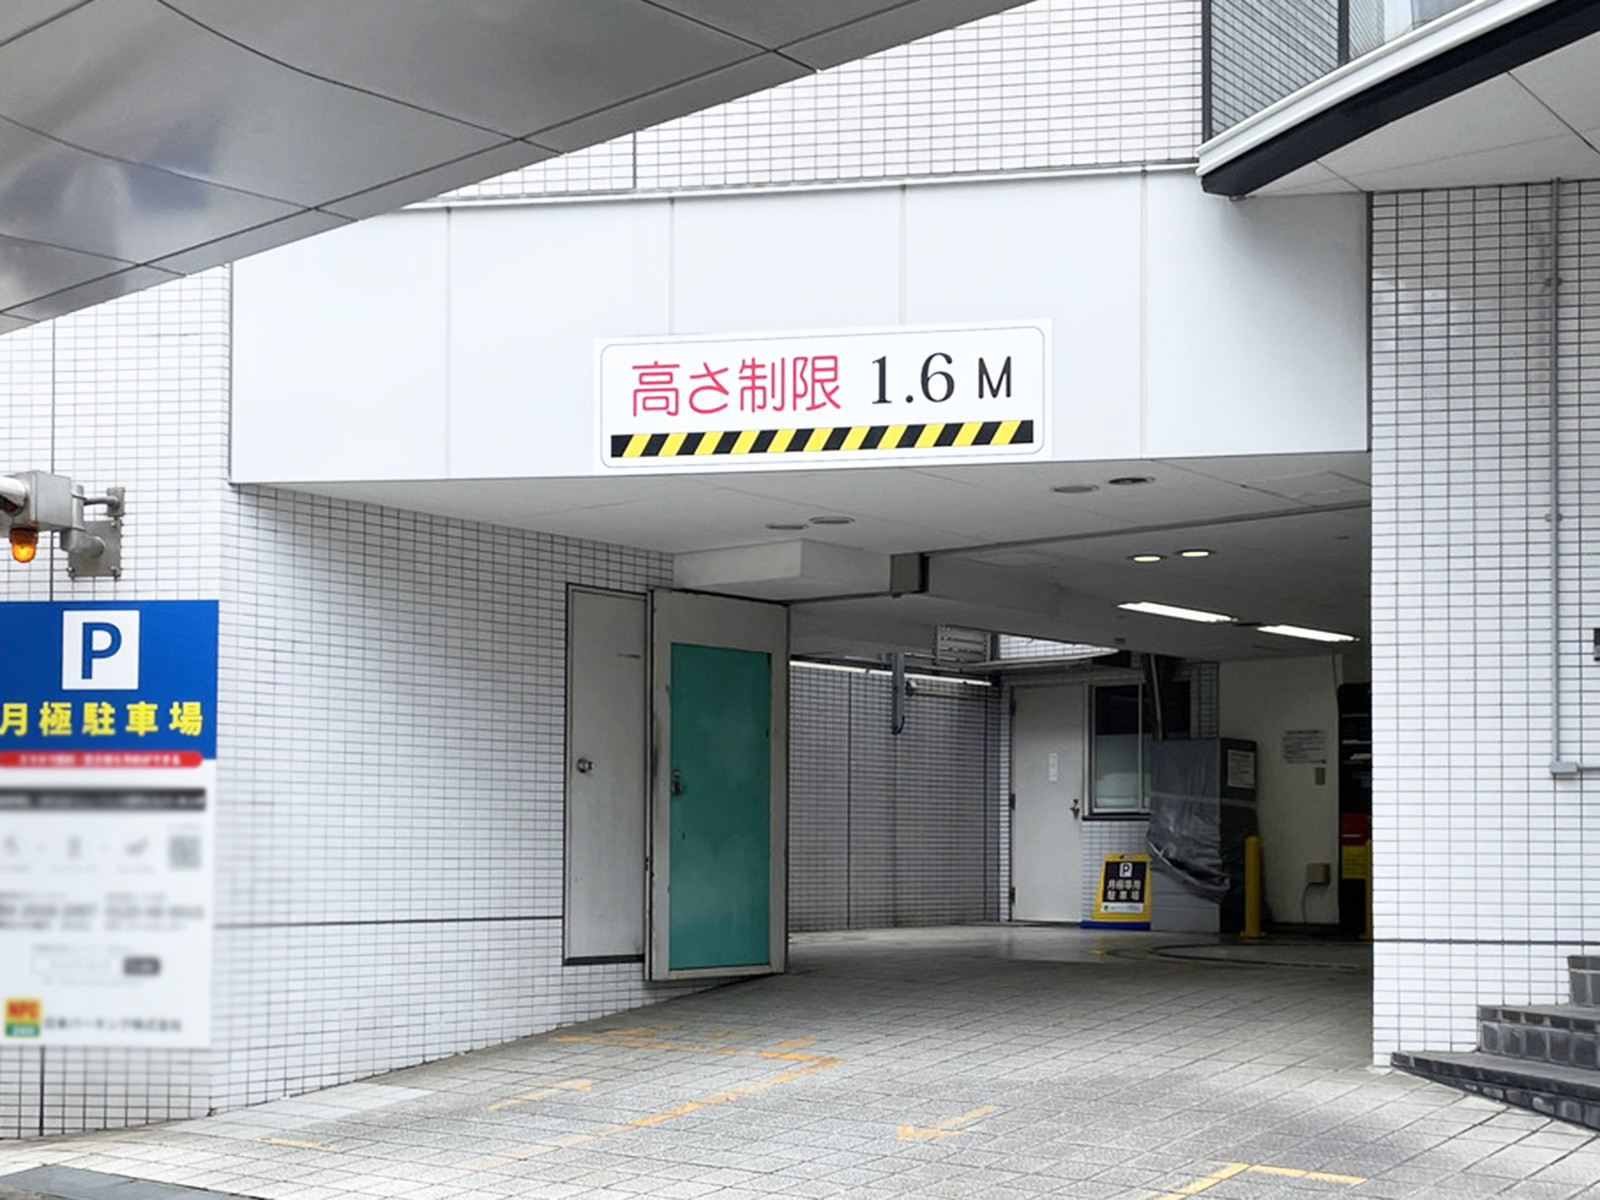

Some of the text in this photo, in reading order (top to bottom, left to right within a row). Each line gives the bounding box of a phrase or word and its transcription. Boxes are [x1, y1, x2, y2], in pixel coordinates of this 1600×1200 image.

[632, 352, 1012, 417] 高さ制限 1.6 M
[81, 621, 122, 680] P
[0, 701, 203, 736] 月極駐車場
